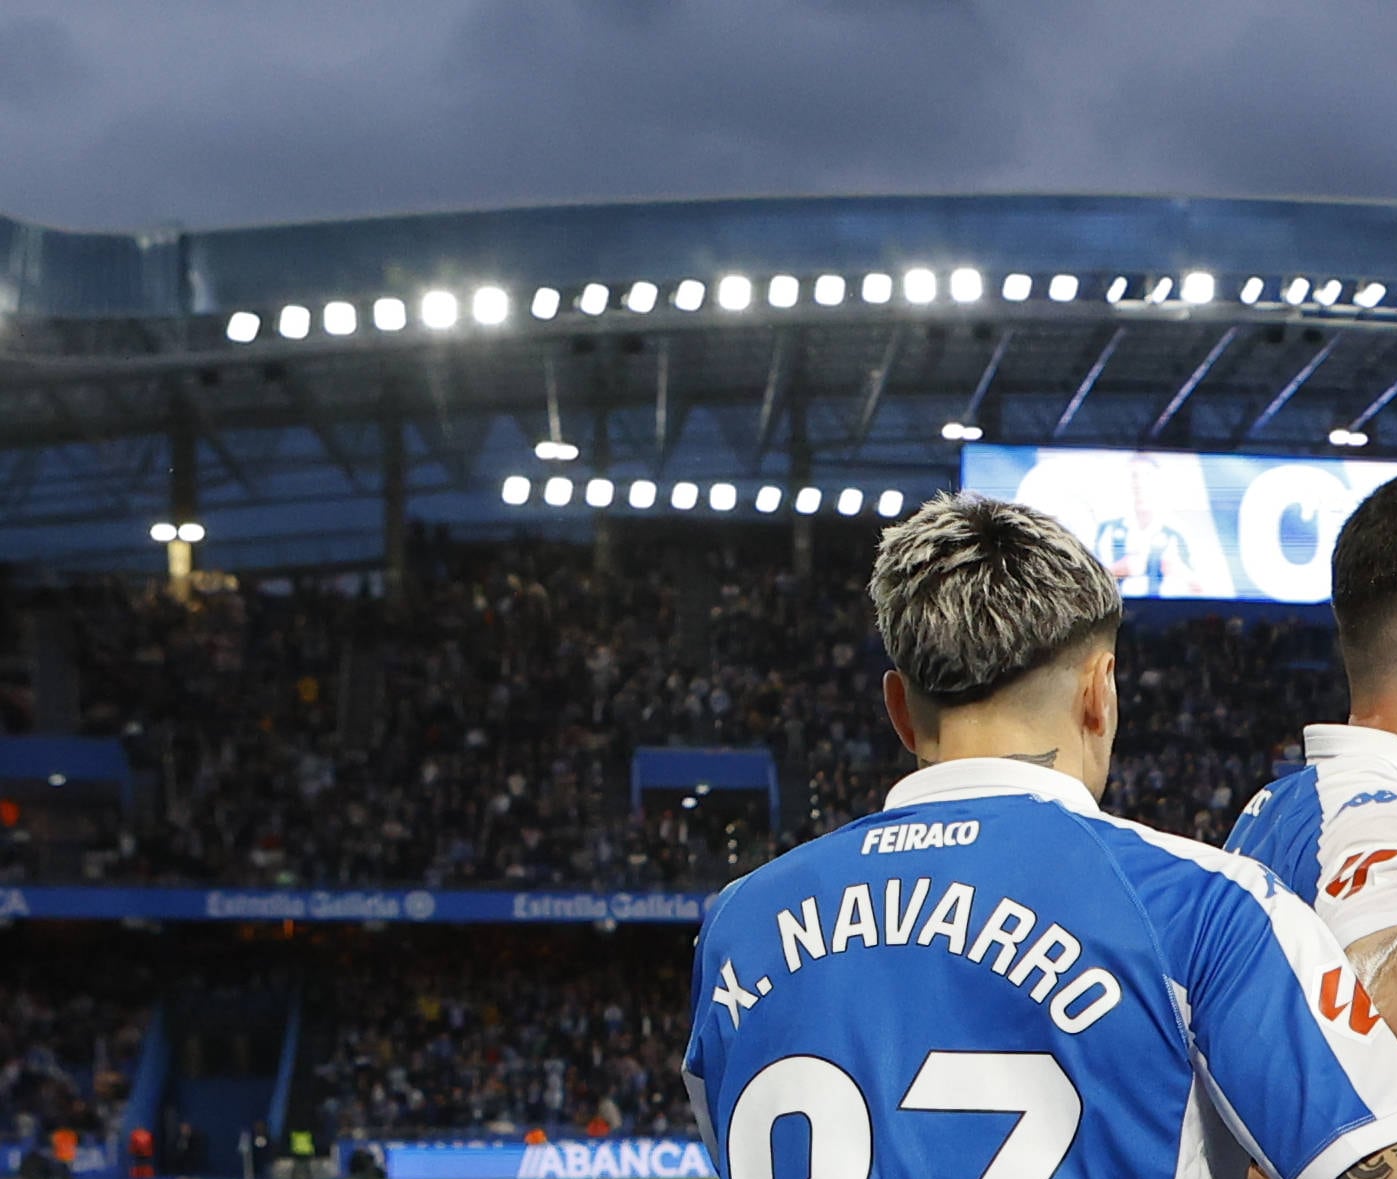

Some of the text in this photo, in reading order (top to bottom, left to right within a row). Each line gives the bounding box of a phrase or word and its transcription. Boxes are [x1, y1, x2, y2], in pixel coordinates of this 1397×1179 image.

[861, 819, 980, 856] FEIRACO
[711, 877, 1122, 1035] X. NAVARRO
